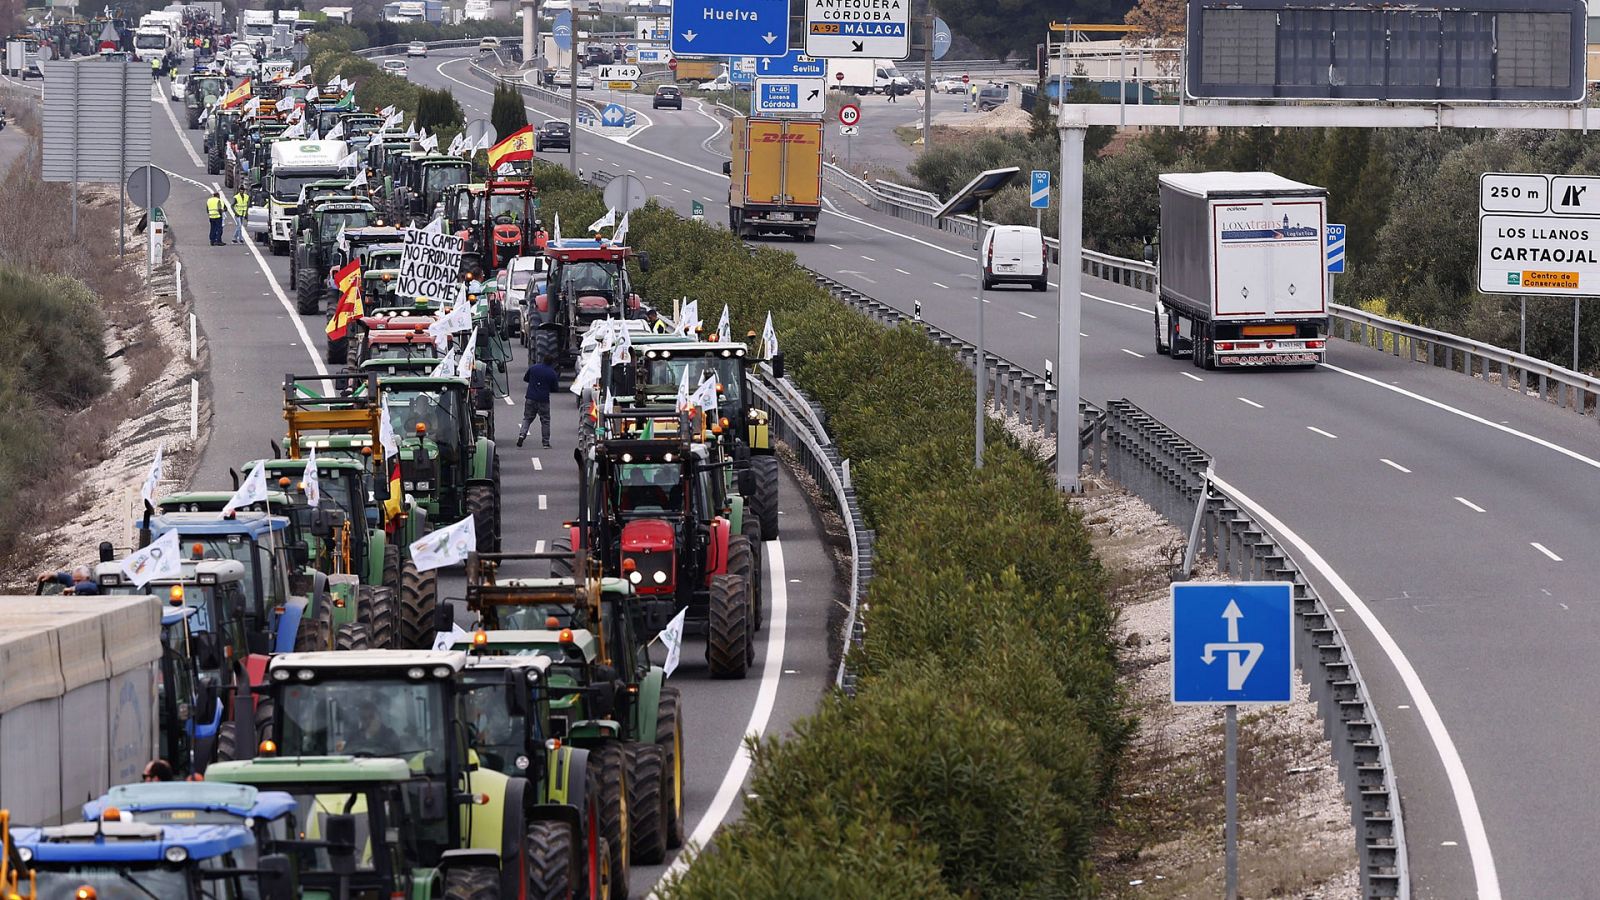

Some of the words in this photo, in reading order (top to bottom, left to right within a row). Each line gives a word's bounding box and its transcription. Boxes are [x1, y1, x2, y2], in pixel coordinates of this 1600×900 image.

[816, 0, 900, 9] ANTEQUERA
[703, 7, 758, 21] Huelva
[823, 9, 891, 20] CÓRDOBA
[812, 24, 839, 33] A-92
[845, 23, 902, 34] MÁLAGA
[617, 69, 636, 77] 149
[793, 65, 820, 73] Sevilla
[762, 133, 807, 144] DHL
[1490, 186, 1521, 198] 250
[1527, 190, 1539, 199] m
[405, 230, 418, 244] SI
[418, 232, 431, 246] EL
[431, 234, 464, 251] CAMPO
[1498, 227, 1526, 238] LOS
[1532, 229, 1589, 241] LLANOS
[404, 245, 420, 260] NO
[421, 248, 460, 267] PRODUCE
[1490, 246, 1598, 263] CARTAOJAL
[401, 260, 414, 277] LA
[416, 264, 458, 283] CIUDAD
[398, 277, 417, 295] NO
